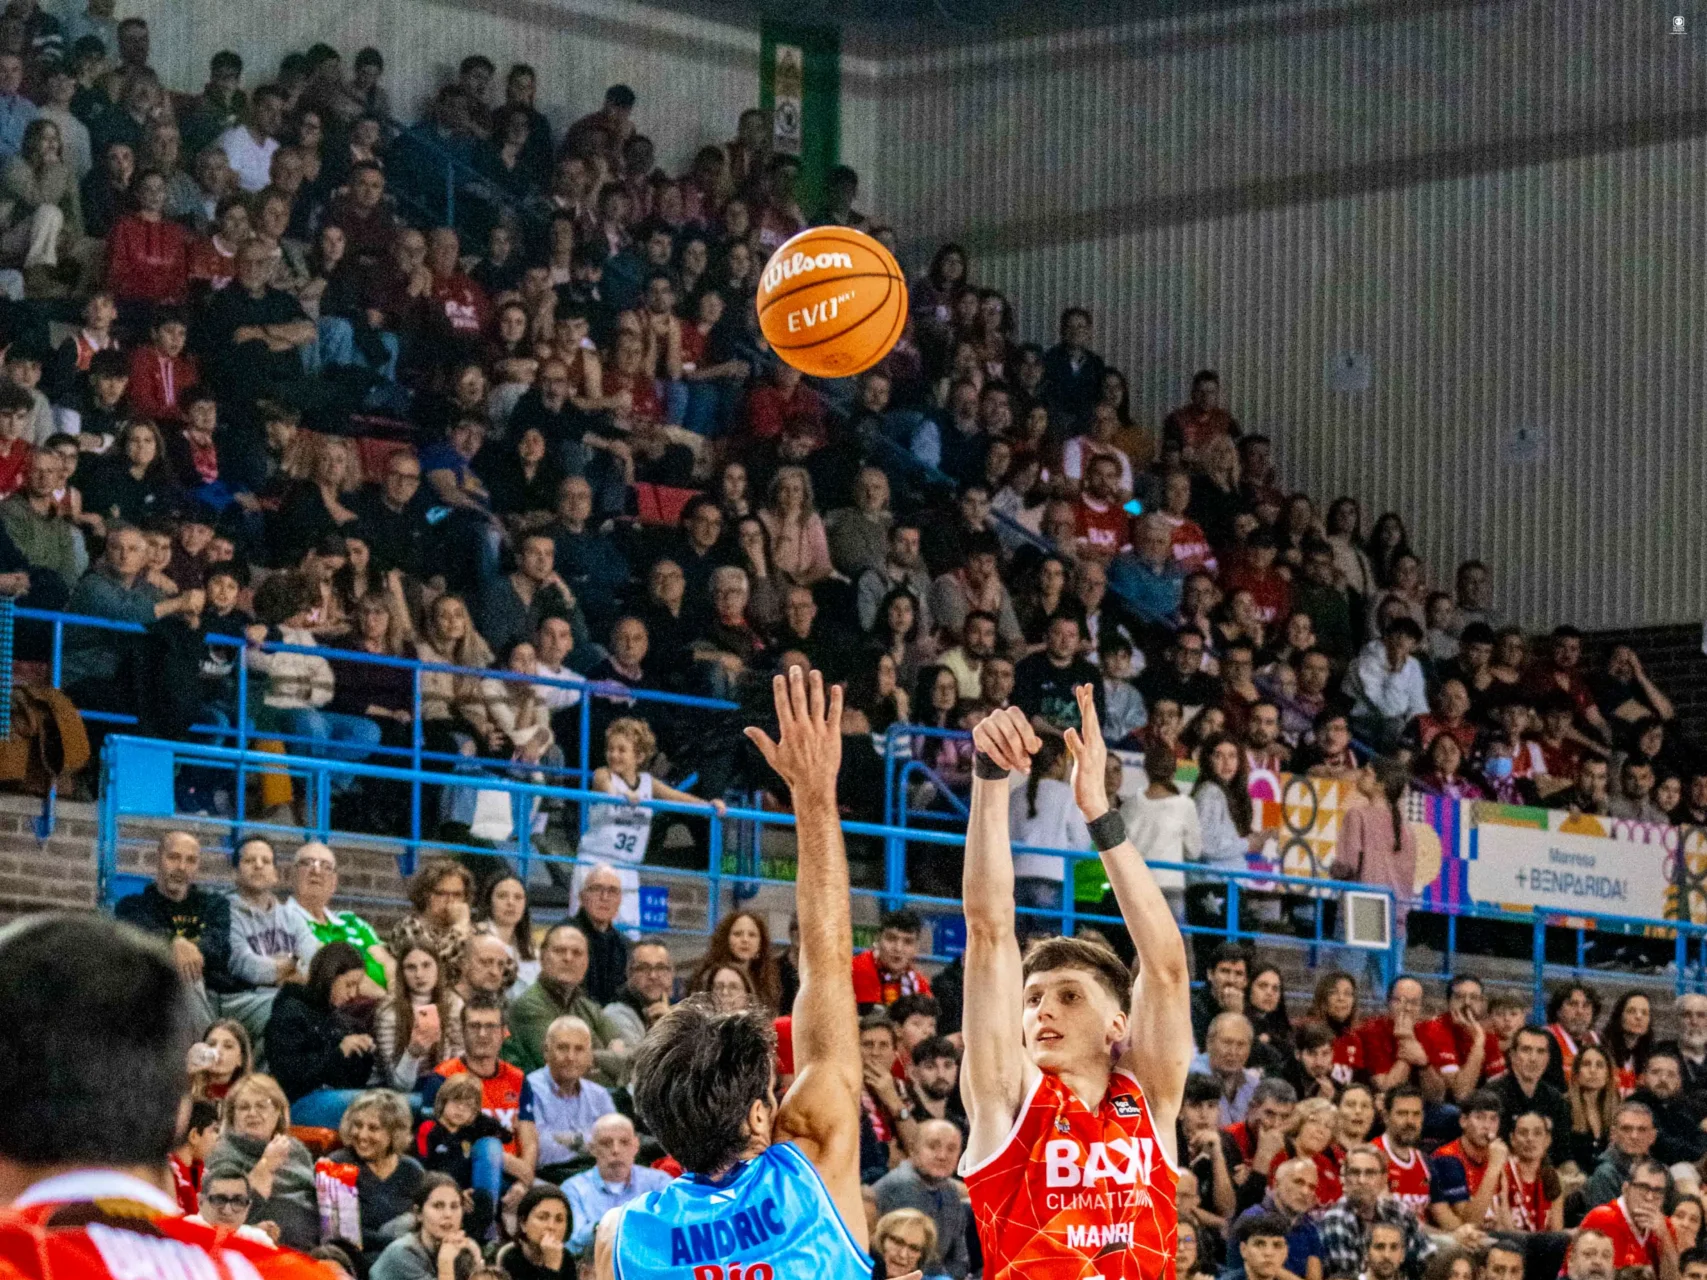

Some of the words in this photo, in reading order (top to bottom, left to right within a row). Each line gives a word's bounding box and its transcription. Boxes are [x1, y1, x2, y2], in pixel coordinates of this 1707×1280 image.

[762, 252, 853, 293] Wilson
[614, 832, 638, 853] 32
[671, 1198, 787, 1267] ANDRIC
